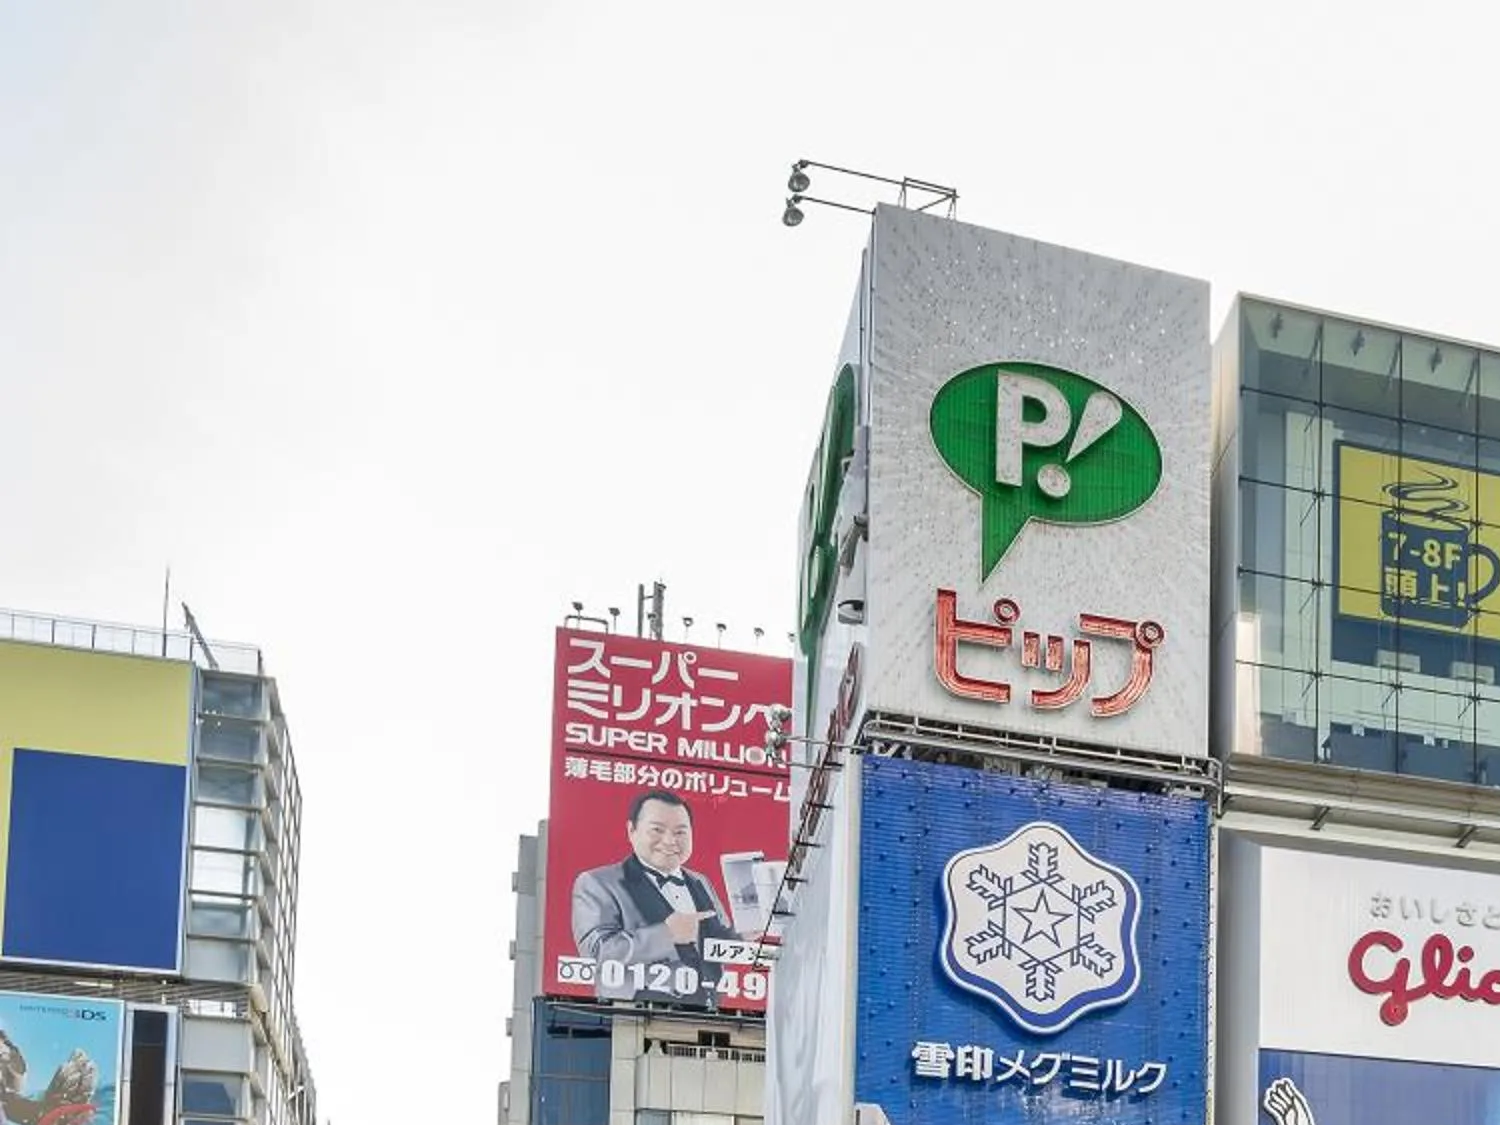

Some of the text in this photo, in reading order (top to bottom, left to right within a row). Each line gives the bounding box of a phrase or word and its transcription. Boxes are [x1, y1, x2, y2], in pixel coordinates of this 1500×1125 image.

[1388, 532, 1463, 571] 7-8F
[567, 638, 739, 688] スーパー
[935, 588, 1166, 717] ピップ
[565, 723, 668, 754] SUPER
[564, 756, 791, 802] 薄毛部分のボリューム
[600, 958, 768, 999] 0120-49
[911, 1040, 1168, 1094] 雪印メグミルク
